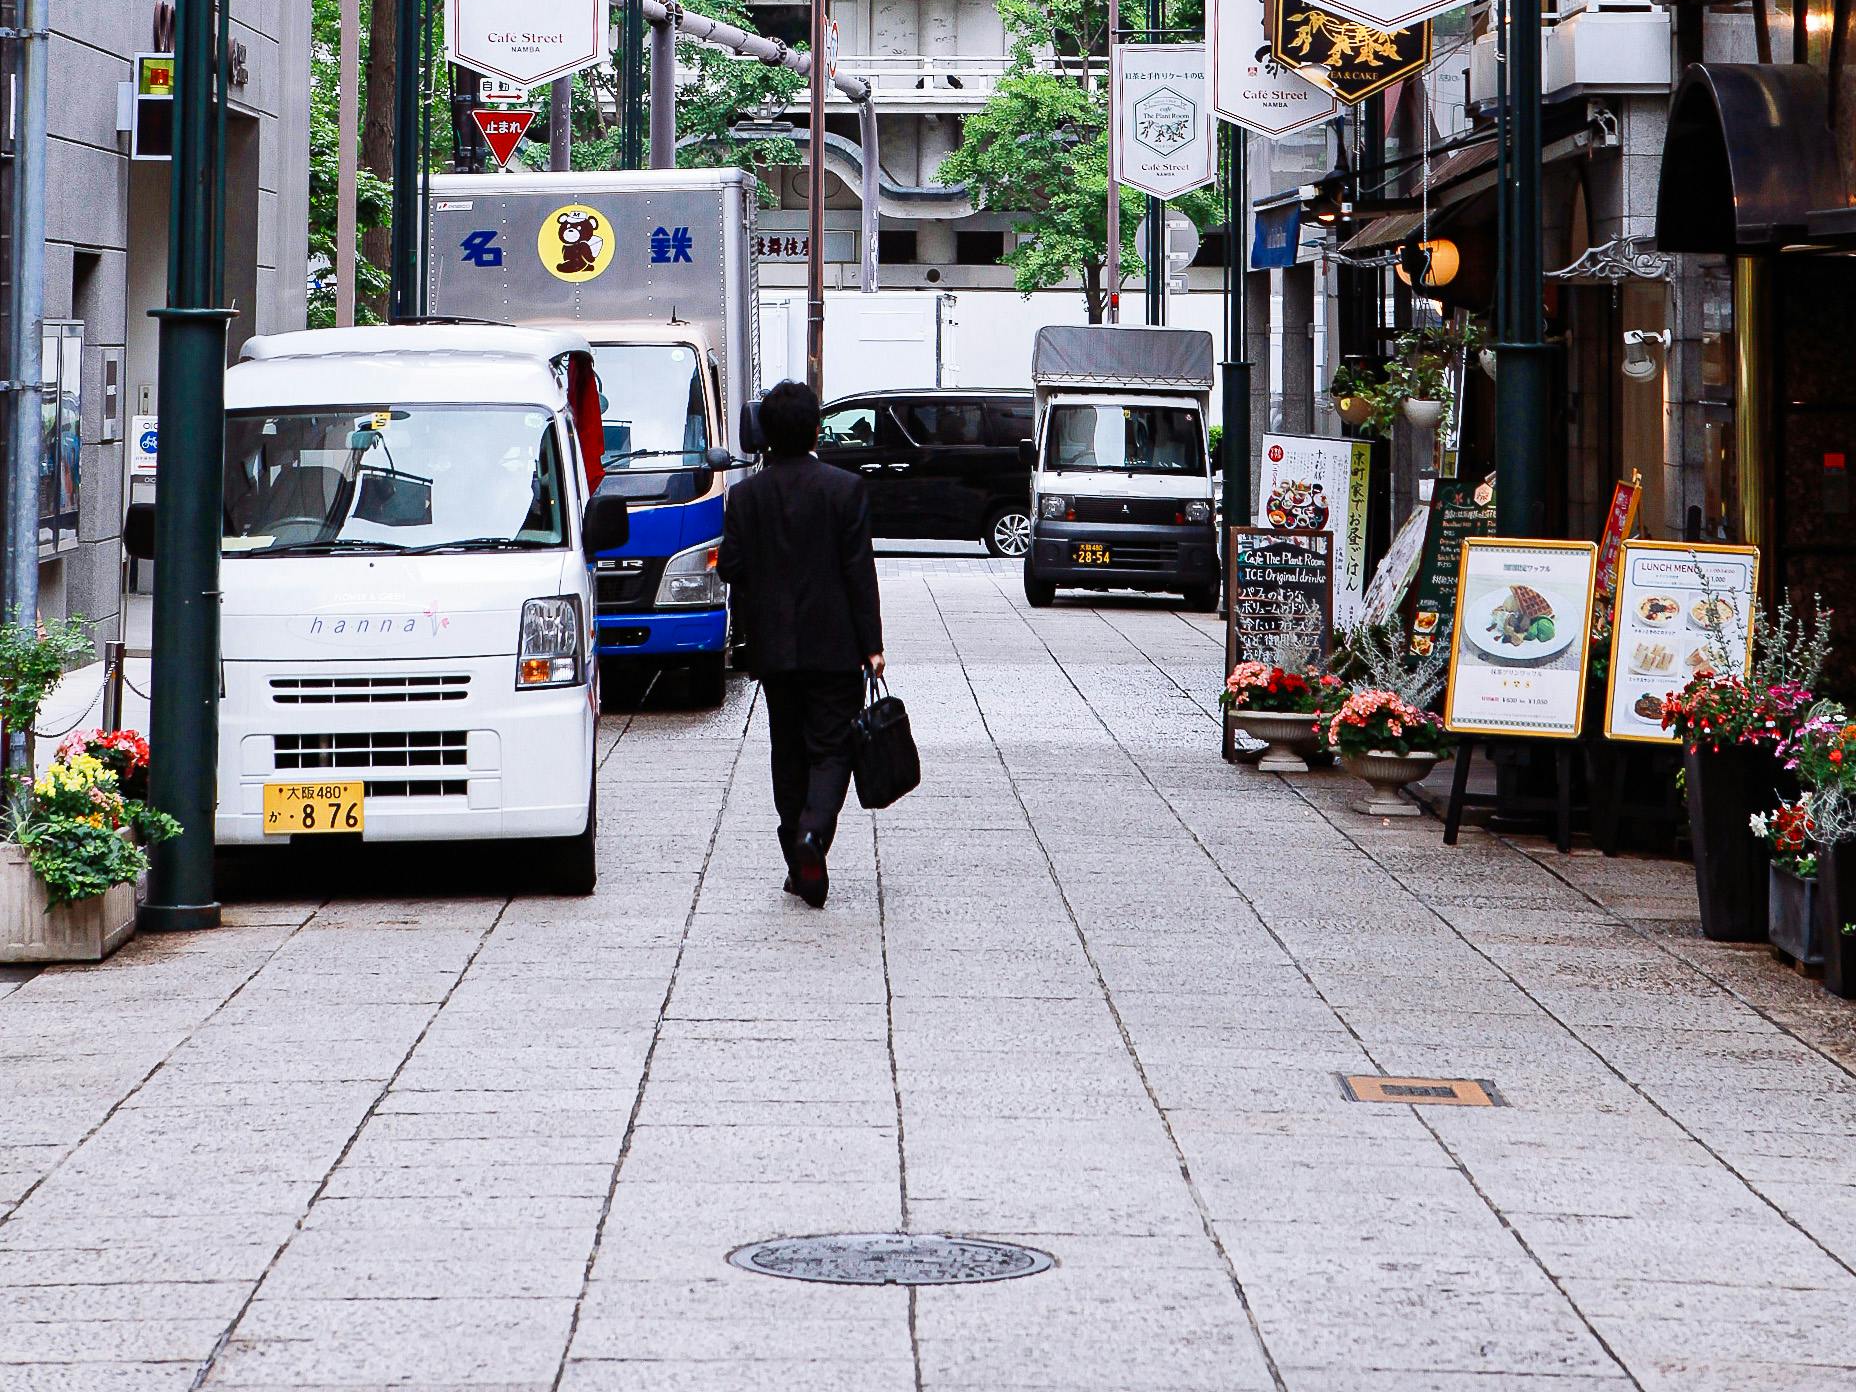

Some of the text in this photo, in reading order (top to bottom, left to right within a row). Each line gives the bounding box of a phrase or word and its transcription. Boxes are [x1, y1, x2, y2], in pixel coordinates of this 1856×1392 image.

[488, 32, 564, 44] Café Street
[1353, 71, 1380, 80] CAKE
[1243, 89, 1308, 100] Café Street
[485, 120, 522, 134] 止まれ
[1141, 163, 1189, 171] Café Street
[460, 226, 692, 267] 名 鉄
[1264, 552, 1280, 564] The
[1282, 552, 1303, 565] Plant
[1641, 562, 1672, 572] LUNCH
[1245, 568, 1327, 585] ICE Original drinks
[269, 810, 281, 823] か
